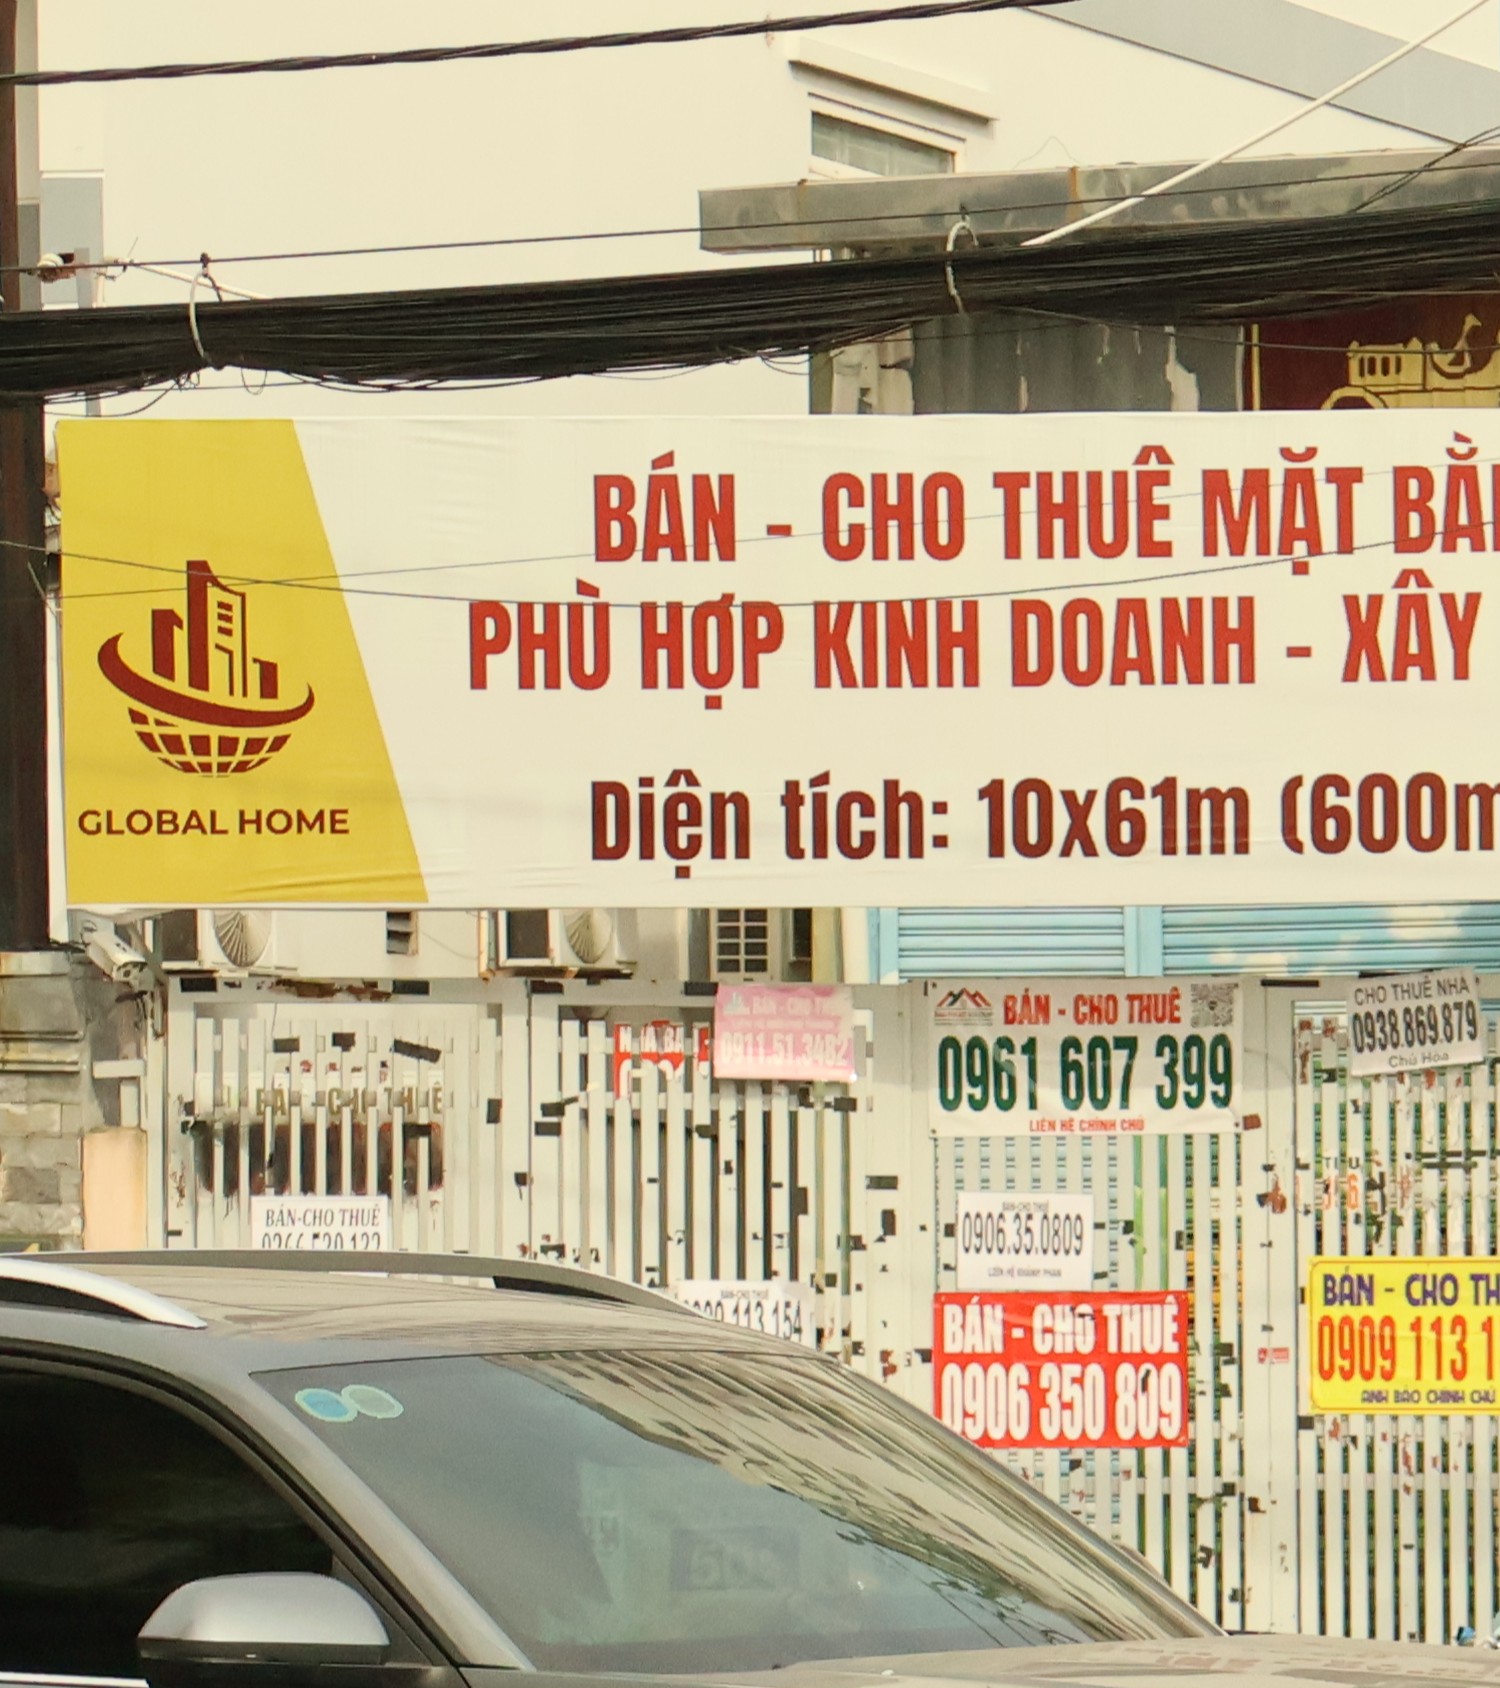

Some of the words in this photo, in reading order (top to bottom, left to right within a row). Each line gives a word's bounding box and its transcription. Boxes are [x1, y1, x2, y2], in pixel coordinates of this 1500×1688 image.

[592, 450, 736, 563] BÁN
[822, 471, 965, 562] CHO
[993, 445, 1173, 559] THUÊ
[1202, 446, 1363, 576] MẶT
[469, 579, 610, 690] PHÙ
[641, 593, 784, 709] HỢP
[814, 597, 980, 690] KINH
[1011, 596, 1256, 688] DOANH
[1342, 568, 1481, 682] XÂY
[77, 809, 229, 836] GLOBAL
[238, 808, 350, 835] HOME
[591, 769, 750, 879] Diện
[782, 770, 949, 861] tích:
[978, 775, 1250, 861] 10x61m
[1003, 988, 1050, 1025] BÁN
[1073, 993, 1119, 1025] CHO
[1126, 986, 1181, 1024] THUÊ
[1354, 986, 1387, 1006] CHO
[1391, 976, 1433, 1001] THUÊ
[1352, 1000, 1478, 1053] 0938.869.879
[938, 1035, 1037, 1112] 0961
[1060, 1035, 1138, 1111] 607
[1155, 1033, 1232, 1110] 399
[339, 1203, 380, 1227] THUÊ
[962, 1211, 1084, 1256] 0906.35.0809
[1323, 1266, 1375, 1306] BÁN
[1405, 1273, 1459, 1306] CHO
[943, 1295, 1004, 1354] BÁN
[1032, 1303, 1096, 1355] CHO
[1102, 1294, 1180, 1354] THUÊ
[1318, 1314, 1396, 1381] 0909
[1410, 1314, 1468, 1381] 113
[941, 1362, 1031, 1441] 0906
[1038, 1362, 1105, 1441] 350
[1115, 1362, 1182, 1441] 809
